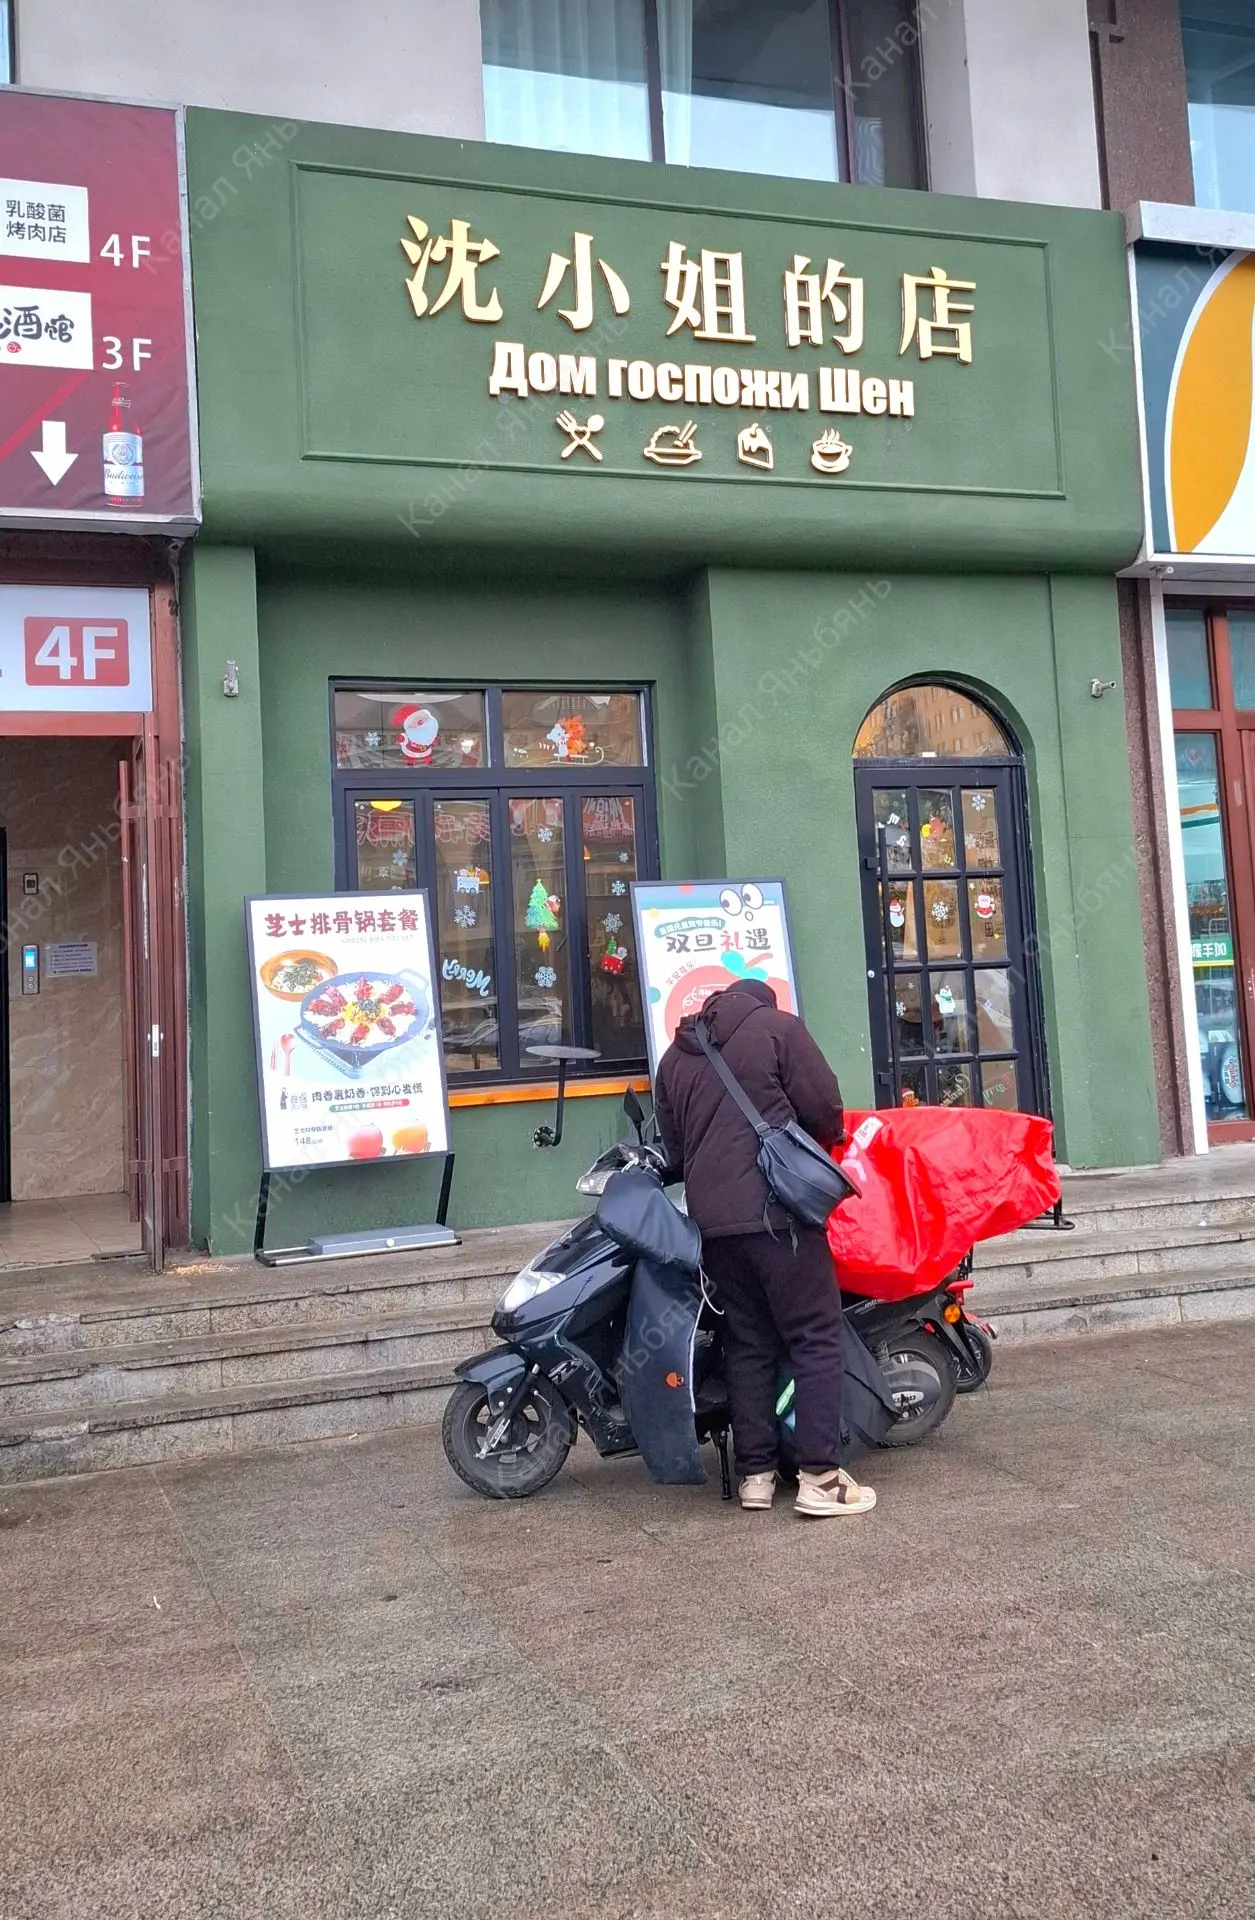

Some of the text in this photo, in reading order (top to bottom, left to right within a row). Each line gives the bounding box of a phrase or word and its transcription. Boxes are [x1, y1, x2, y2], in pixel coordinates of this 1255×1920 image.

[5, 199, 66, 223] 乳酸菌
[6, 220, 67, 244] 烤肉店
[100, 233, 151, 268] 4F
[400, 214, 977, 364] 沈小姐的店
[101, 336, 152, 371] 3F
[489, 341, 915, 417] Дом госпожи Шен
[35, 625, 118, 680] 4F
[264, 908, 420, 938] 芝士排骨锅套餐
[666, 928, 771, 953] 双旦礼遇
